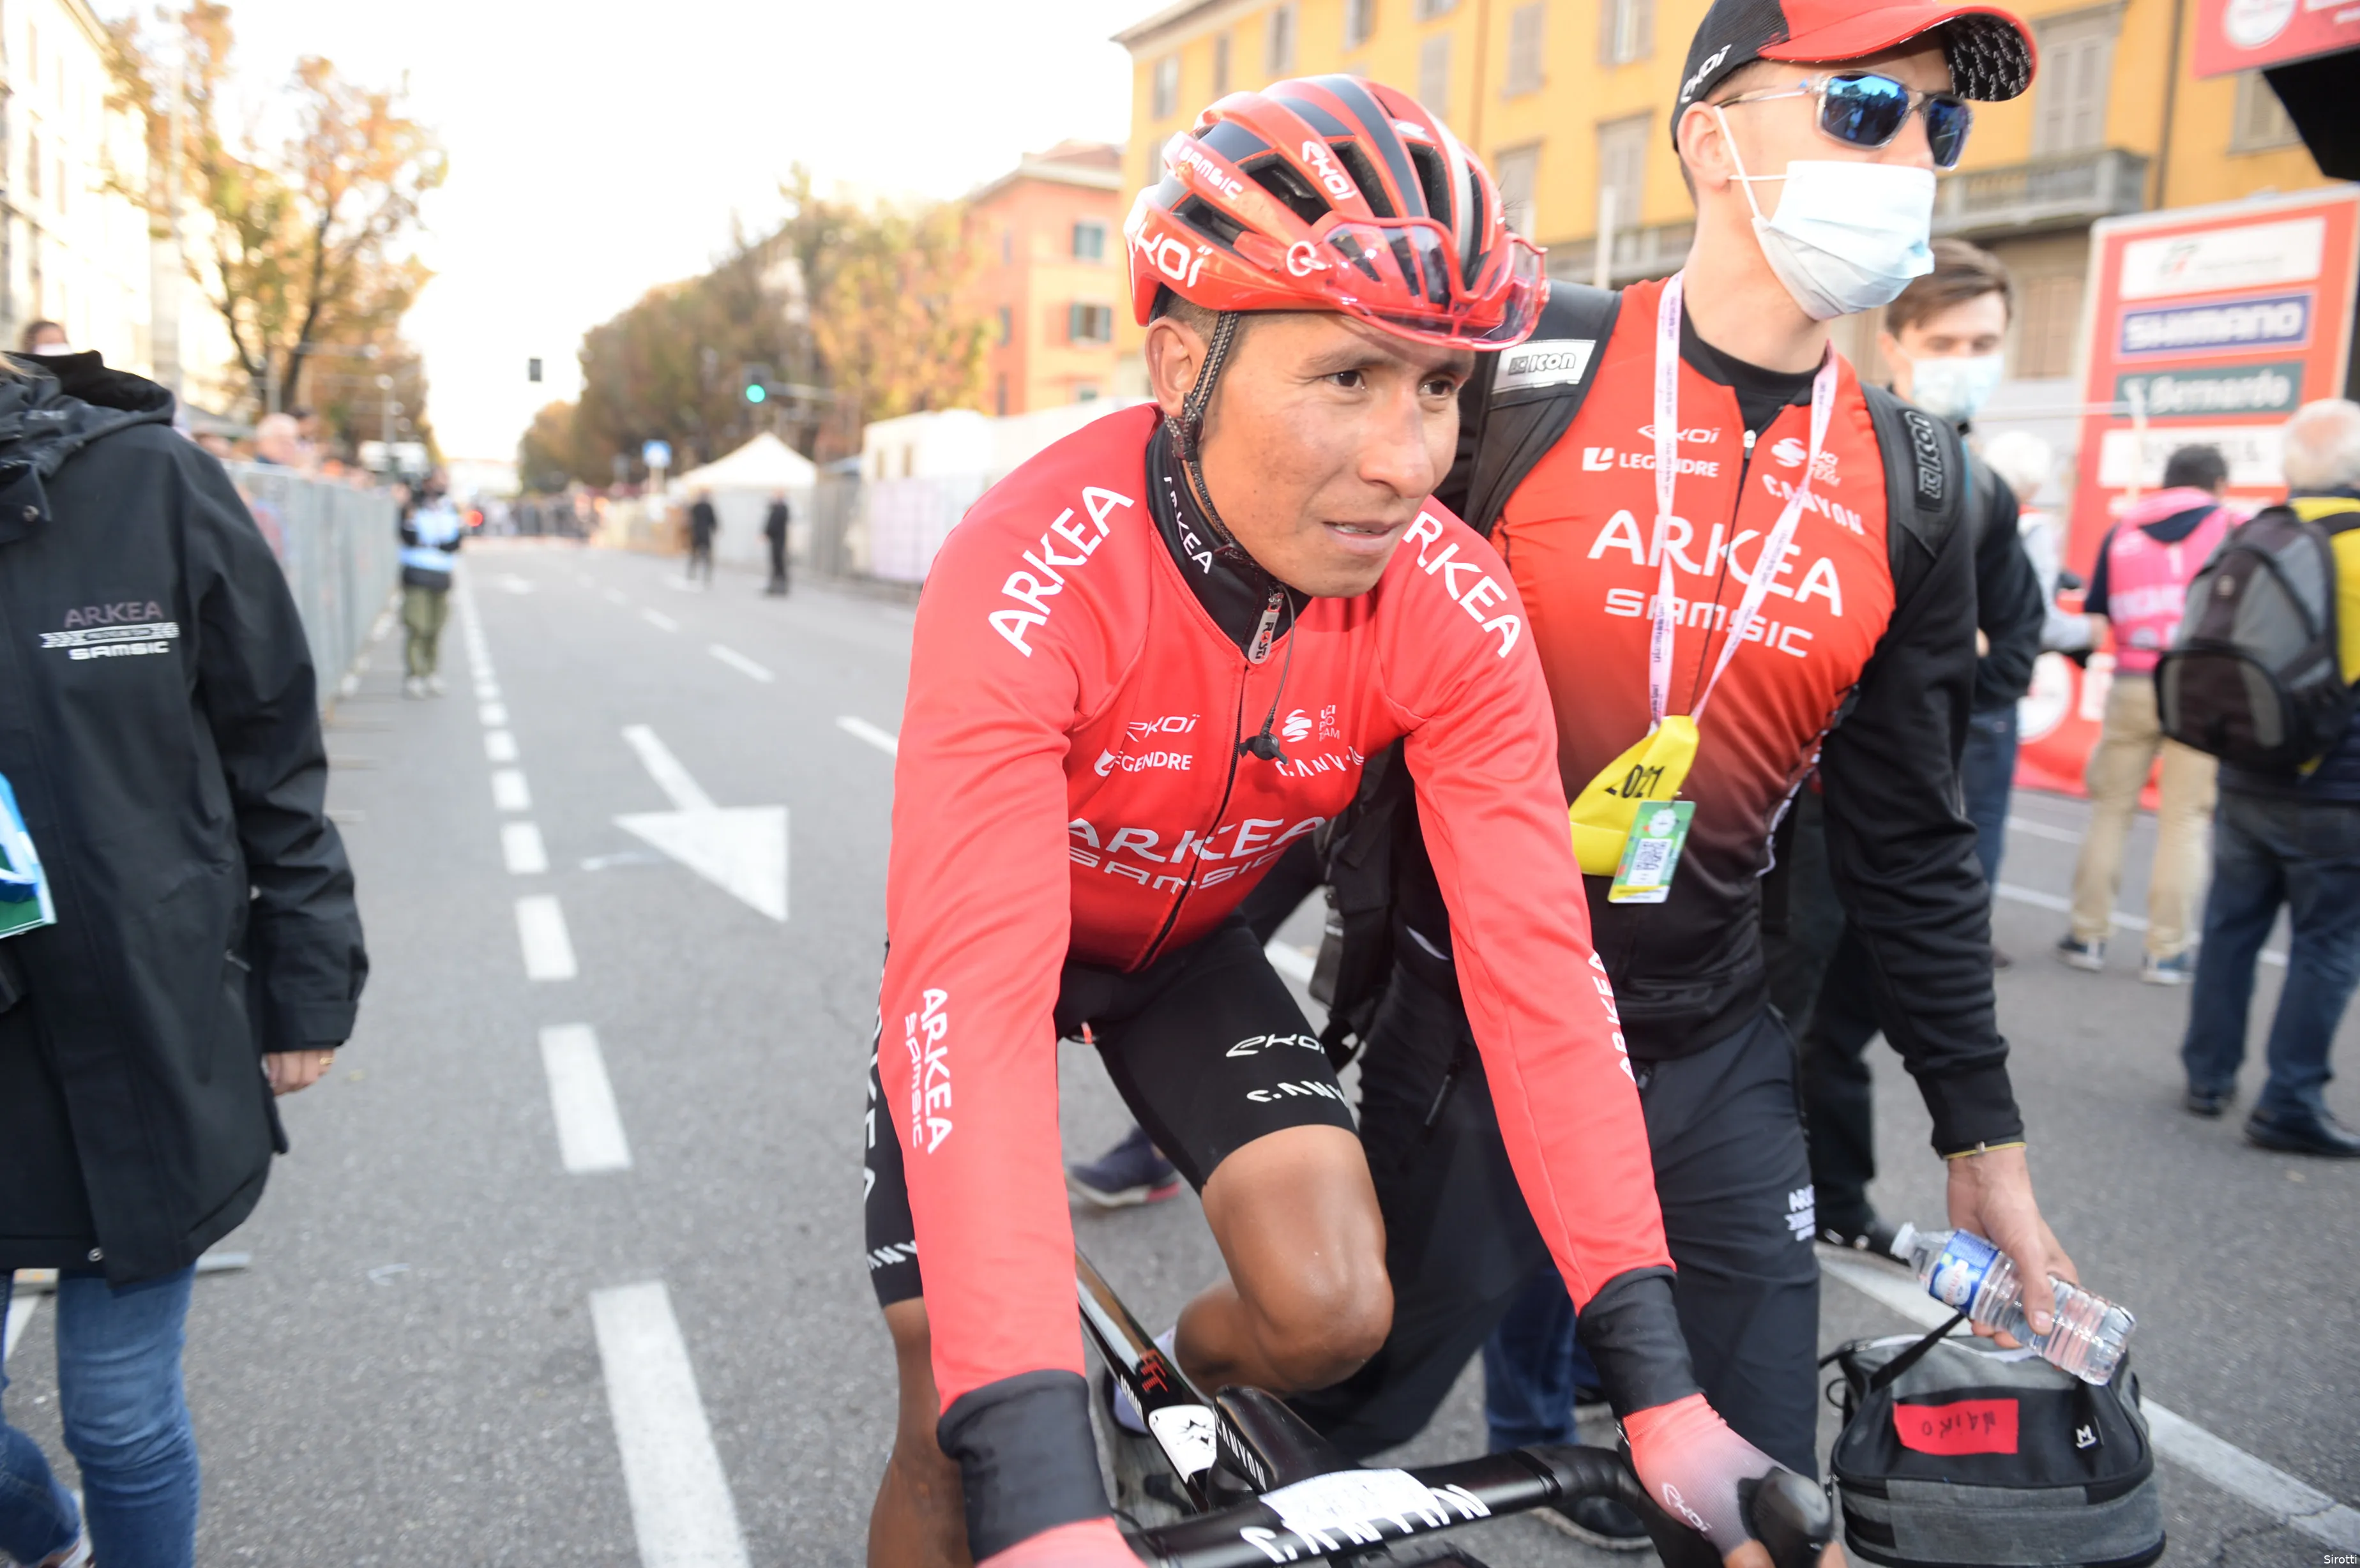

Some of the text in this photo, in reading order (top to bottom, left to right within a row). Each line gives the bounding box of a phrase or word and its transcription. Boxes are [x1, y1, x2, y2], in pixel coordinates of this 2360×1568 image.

[1619, 452, 1720, 478] LEGDRE
[988, 486, 1135, 658] ARKEA
[1402, 511, 1521, 658] RKEA
[1587, 509, 1843, 617] ARKEA
[64, 600, 164, 628] ARKEA
[68, 641, 170, 660] SAMSIC
[1603, 588, 1814, 658] SAMSIC
[1115, 751, 1193, 772] EGENDRE
[1068, 817, 1326, 863] ARKEA
[905, 1012, 923, 1149] SAMSIC
[920, 988, 952, 1154] ARKEA
[1214, 1406, 1267, 1491] CANYON
